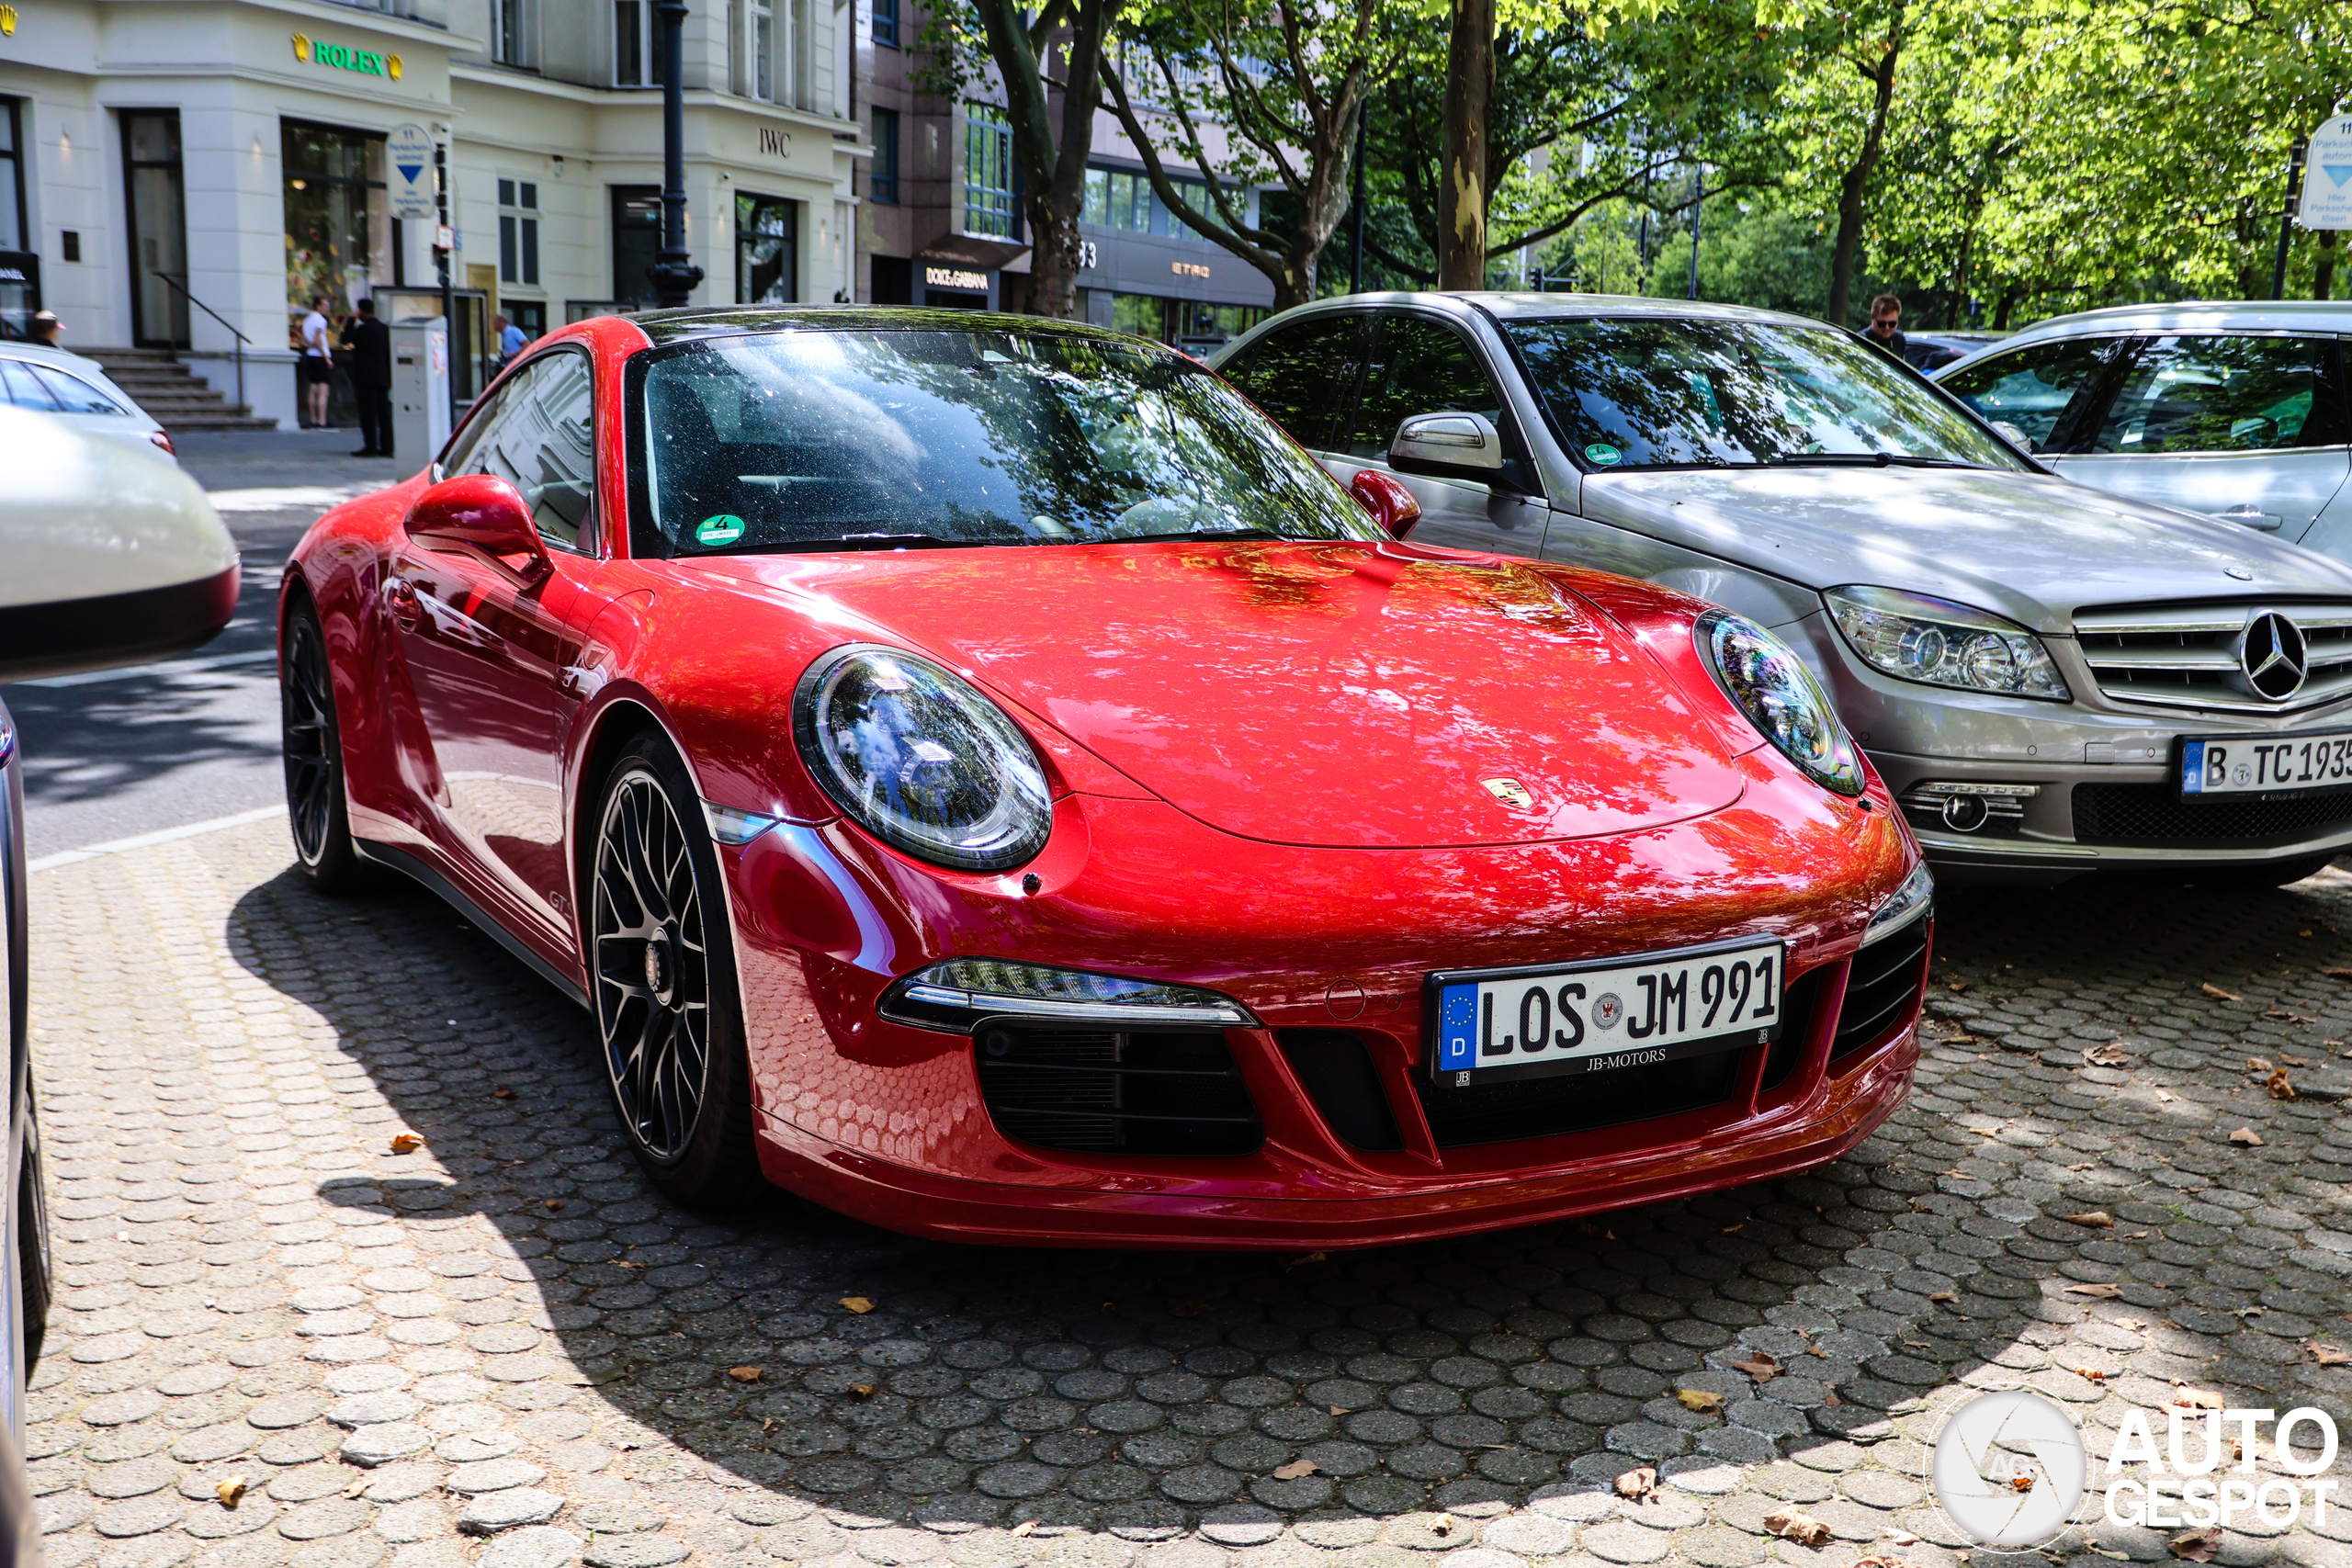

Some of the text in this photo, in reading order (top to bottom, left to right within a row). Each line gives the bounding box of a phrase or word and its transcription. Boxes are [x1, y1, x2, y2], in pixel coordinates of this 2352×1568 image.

[314, 40, 385, 76] ROLEX
[760, 128, 791, 159] IWC
[1171, 262, 1210, 278] ETRO
[715, 516, 729, 530] 4
[2206, 747, 2227, 786] B
[2254, 745, 2292, 784] TC
[2188, 772, 2197, 784] D
[549, 891, 573, 920] GTS
[1482, 953, 1775, 1056] LOS JM 991
[1452, 1037, 1465, 1056] D
[1587, 1048, 1666, 1071] JB-MOTORS
[1457, 1071, 1469, 1082] JB
